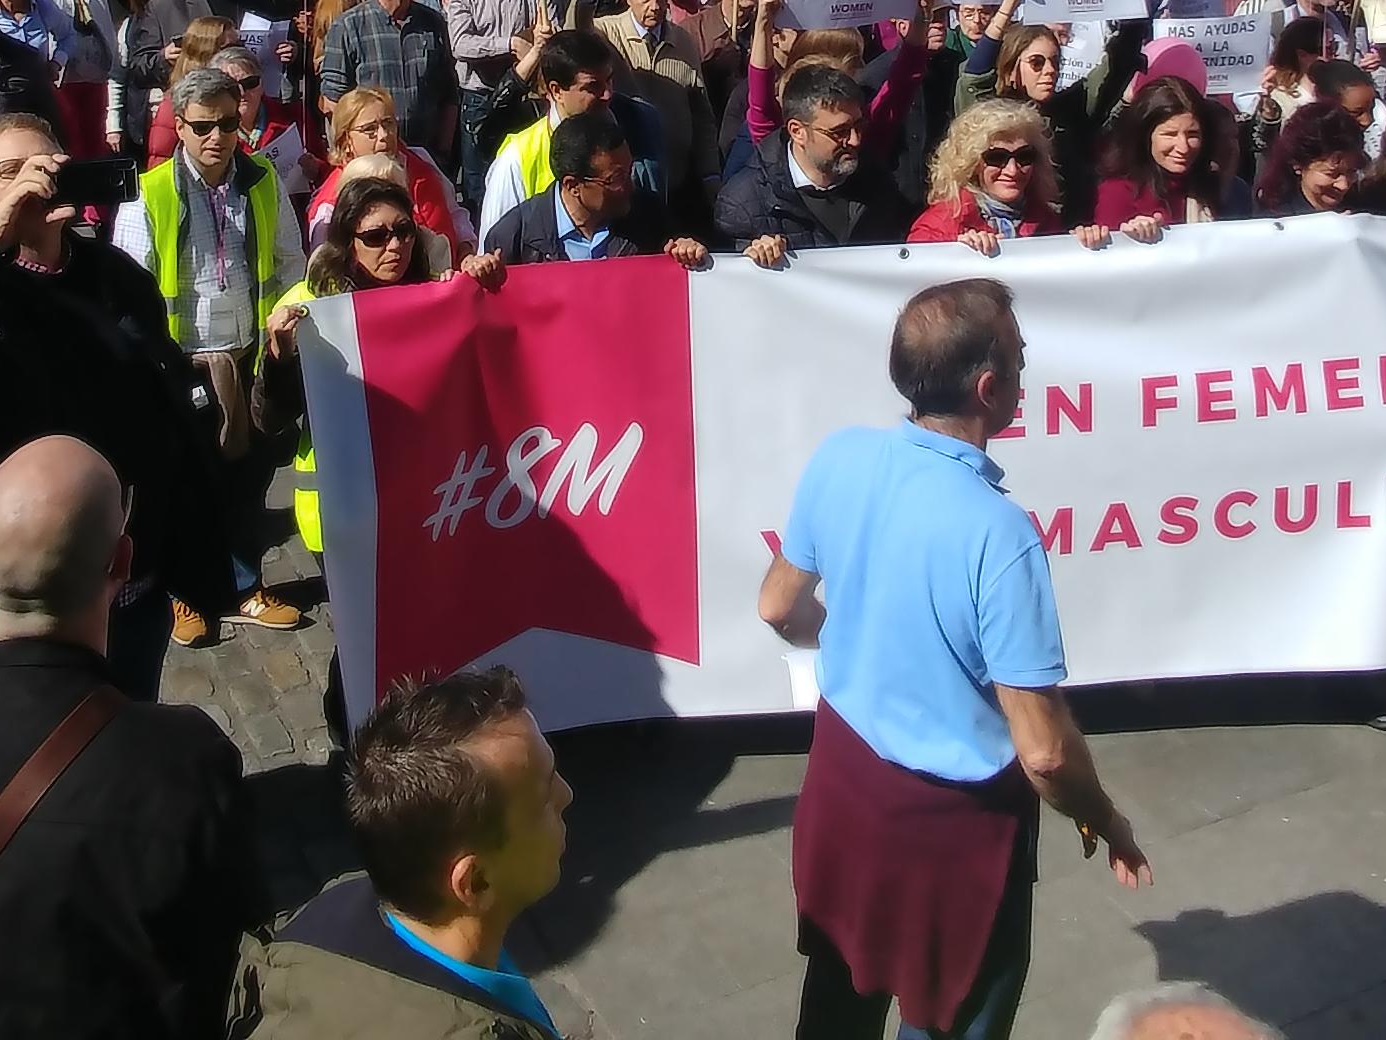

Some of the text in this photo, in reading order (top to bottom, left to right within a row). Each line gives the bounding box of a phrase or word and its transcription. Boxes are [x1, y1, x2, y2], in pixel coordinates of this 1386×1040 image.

[830, 2, 873, 13] WOMEN
[1205, 20, 1256, 37] AYUDAS
[1213, 41, 1229, 52] LA
[1203, 55, 1254, 67] RNIDAD
[991, 382, 1093, 440] EN
[422, 421, 644, 542] #8M
